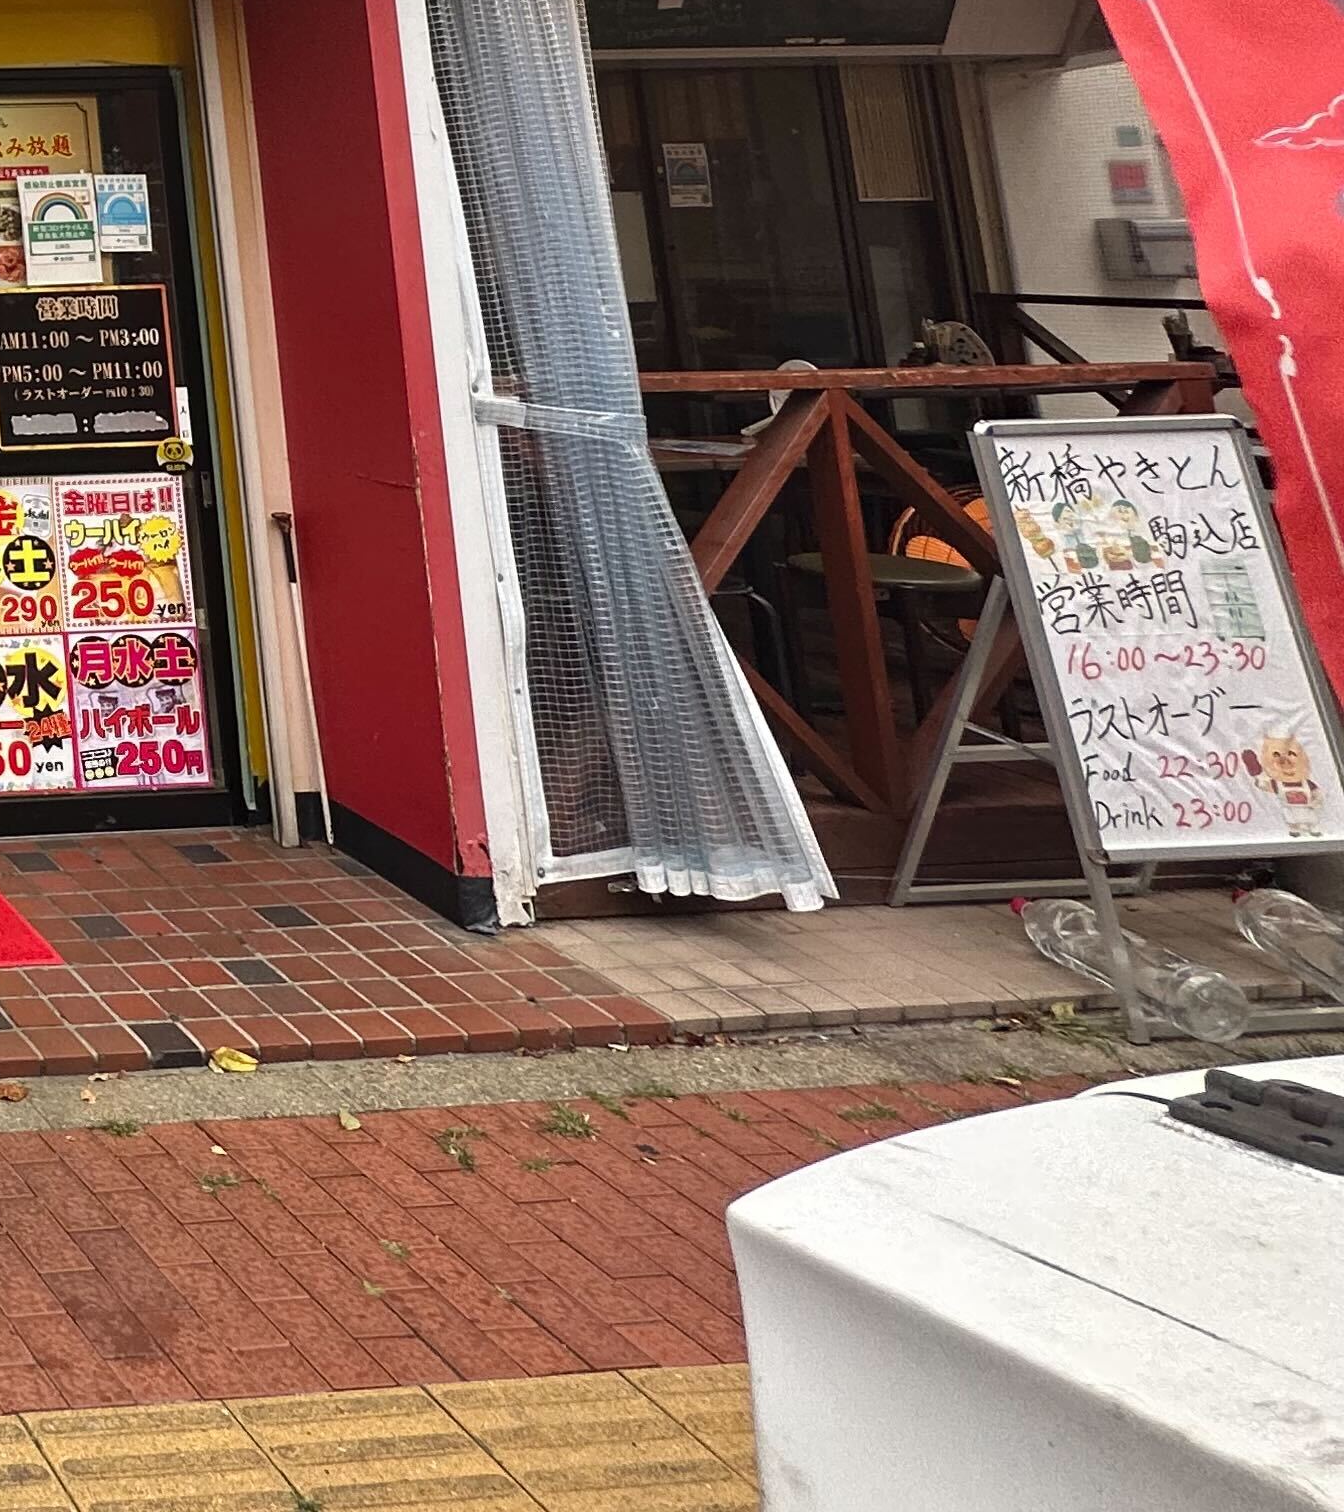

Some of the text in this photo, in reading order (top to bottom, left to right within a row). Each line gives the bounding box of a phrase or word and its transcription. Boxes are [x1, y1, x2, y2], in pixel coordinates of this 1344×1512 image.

[36, 296, 120, 321] 営業時間
[0, 330, 70, 351] AM11:00
[99, 328, 160, 348] PM3:00
[2, 363, 63, 383] PM5:00
[92, 361, 163, 380] PM11:00
[997, 443, 1240, 504] 新橋やきとん
[1148, 508, 1261, 560] 駒込店
[1, 595, 58, 623] 290
[72, 580, 155, 619] 250
[1035, 568, 1199, 636] 営業時間
[77, 636, 194, 684] 月水土
[1068, 686, 1264, 745] ラストオーダー
[35, 760, 64, 773] yen
[1083, 750, 1239, 783] Food 22:30
[1095, 795, 1252, 832] Drink 23:00
